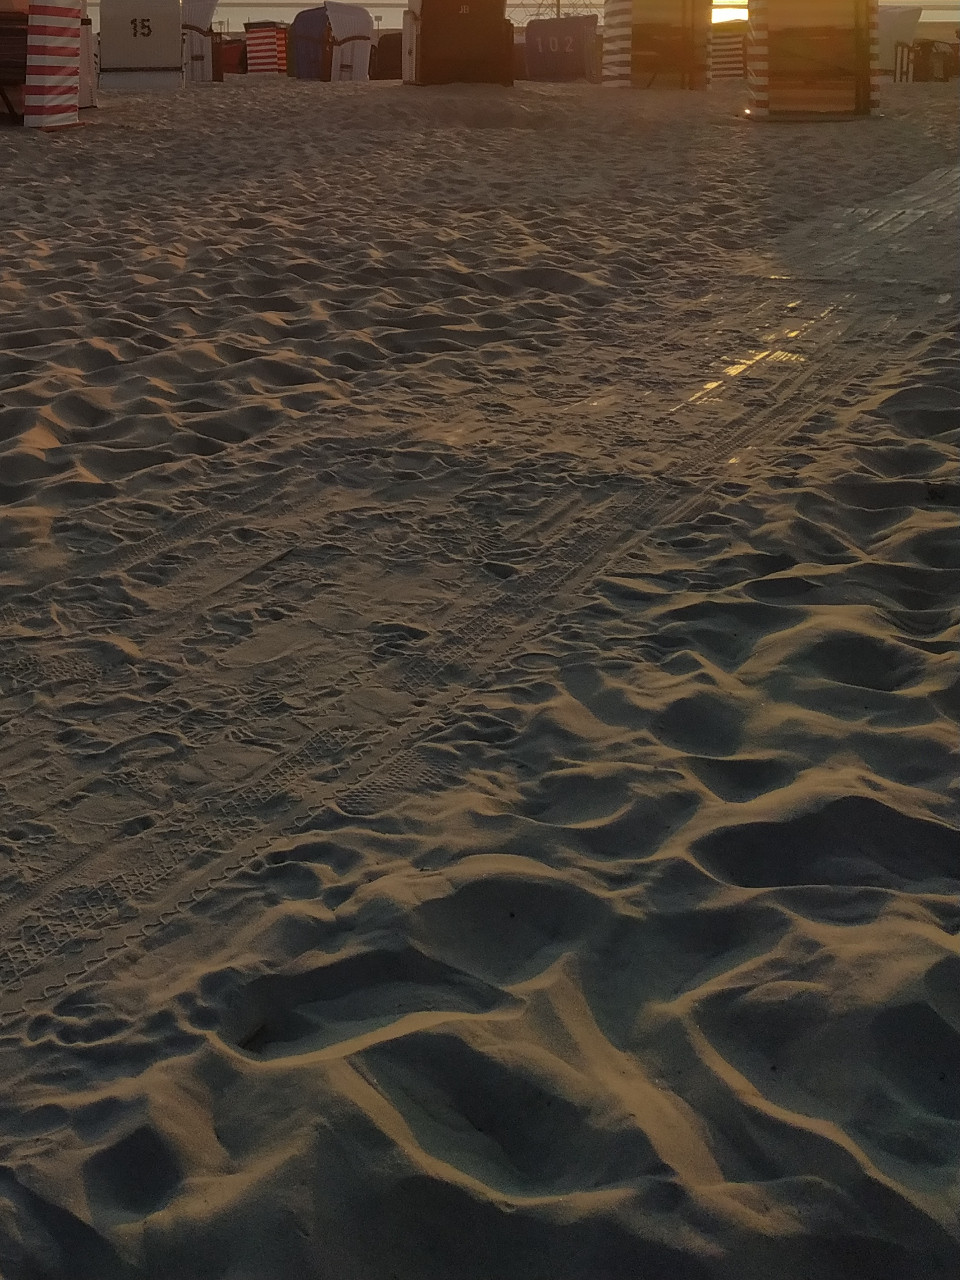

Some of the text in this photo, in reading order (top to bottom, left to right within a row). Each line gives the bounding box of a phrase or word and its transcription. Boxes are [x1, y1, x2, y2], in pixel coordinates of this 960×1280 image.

[458, 4, 470, 14] JB
[130, 18, 153, 37] 15
[536, 36, 573, 53] 102
